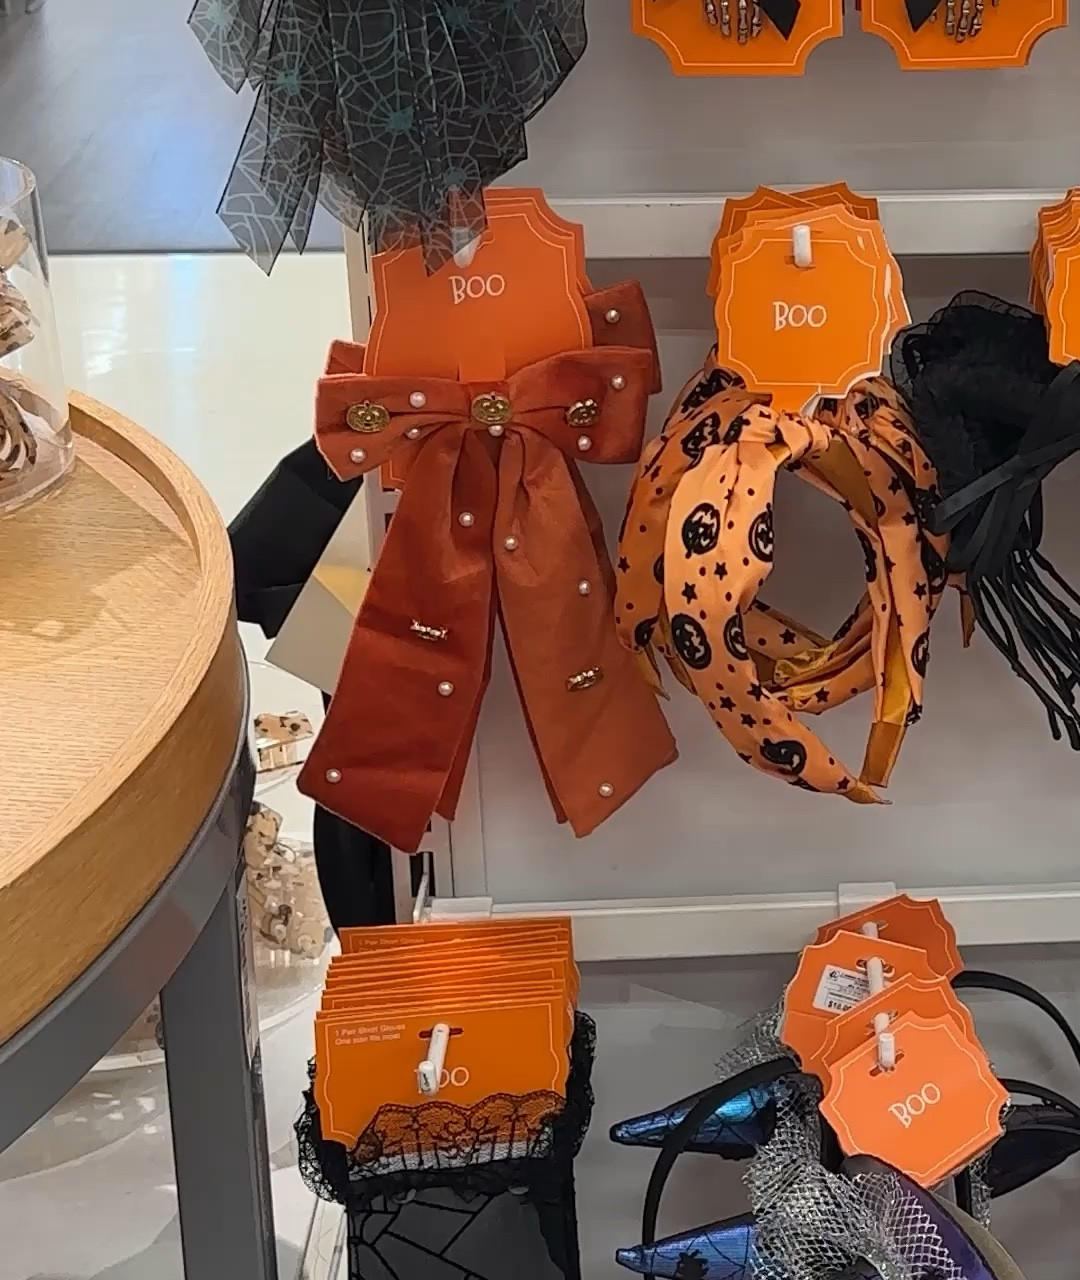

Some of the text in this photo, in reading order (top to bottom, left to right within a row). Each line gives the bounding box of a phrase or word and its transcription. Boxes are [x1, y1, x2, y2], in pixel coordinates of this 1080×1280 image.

[449, 274, 506, 305] BOO
[772, 301, 828, 332] BOO
[379, 1023, 407, 1033] Gloves
[888, 1083, 941, 1128] BOO
